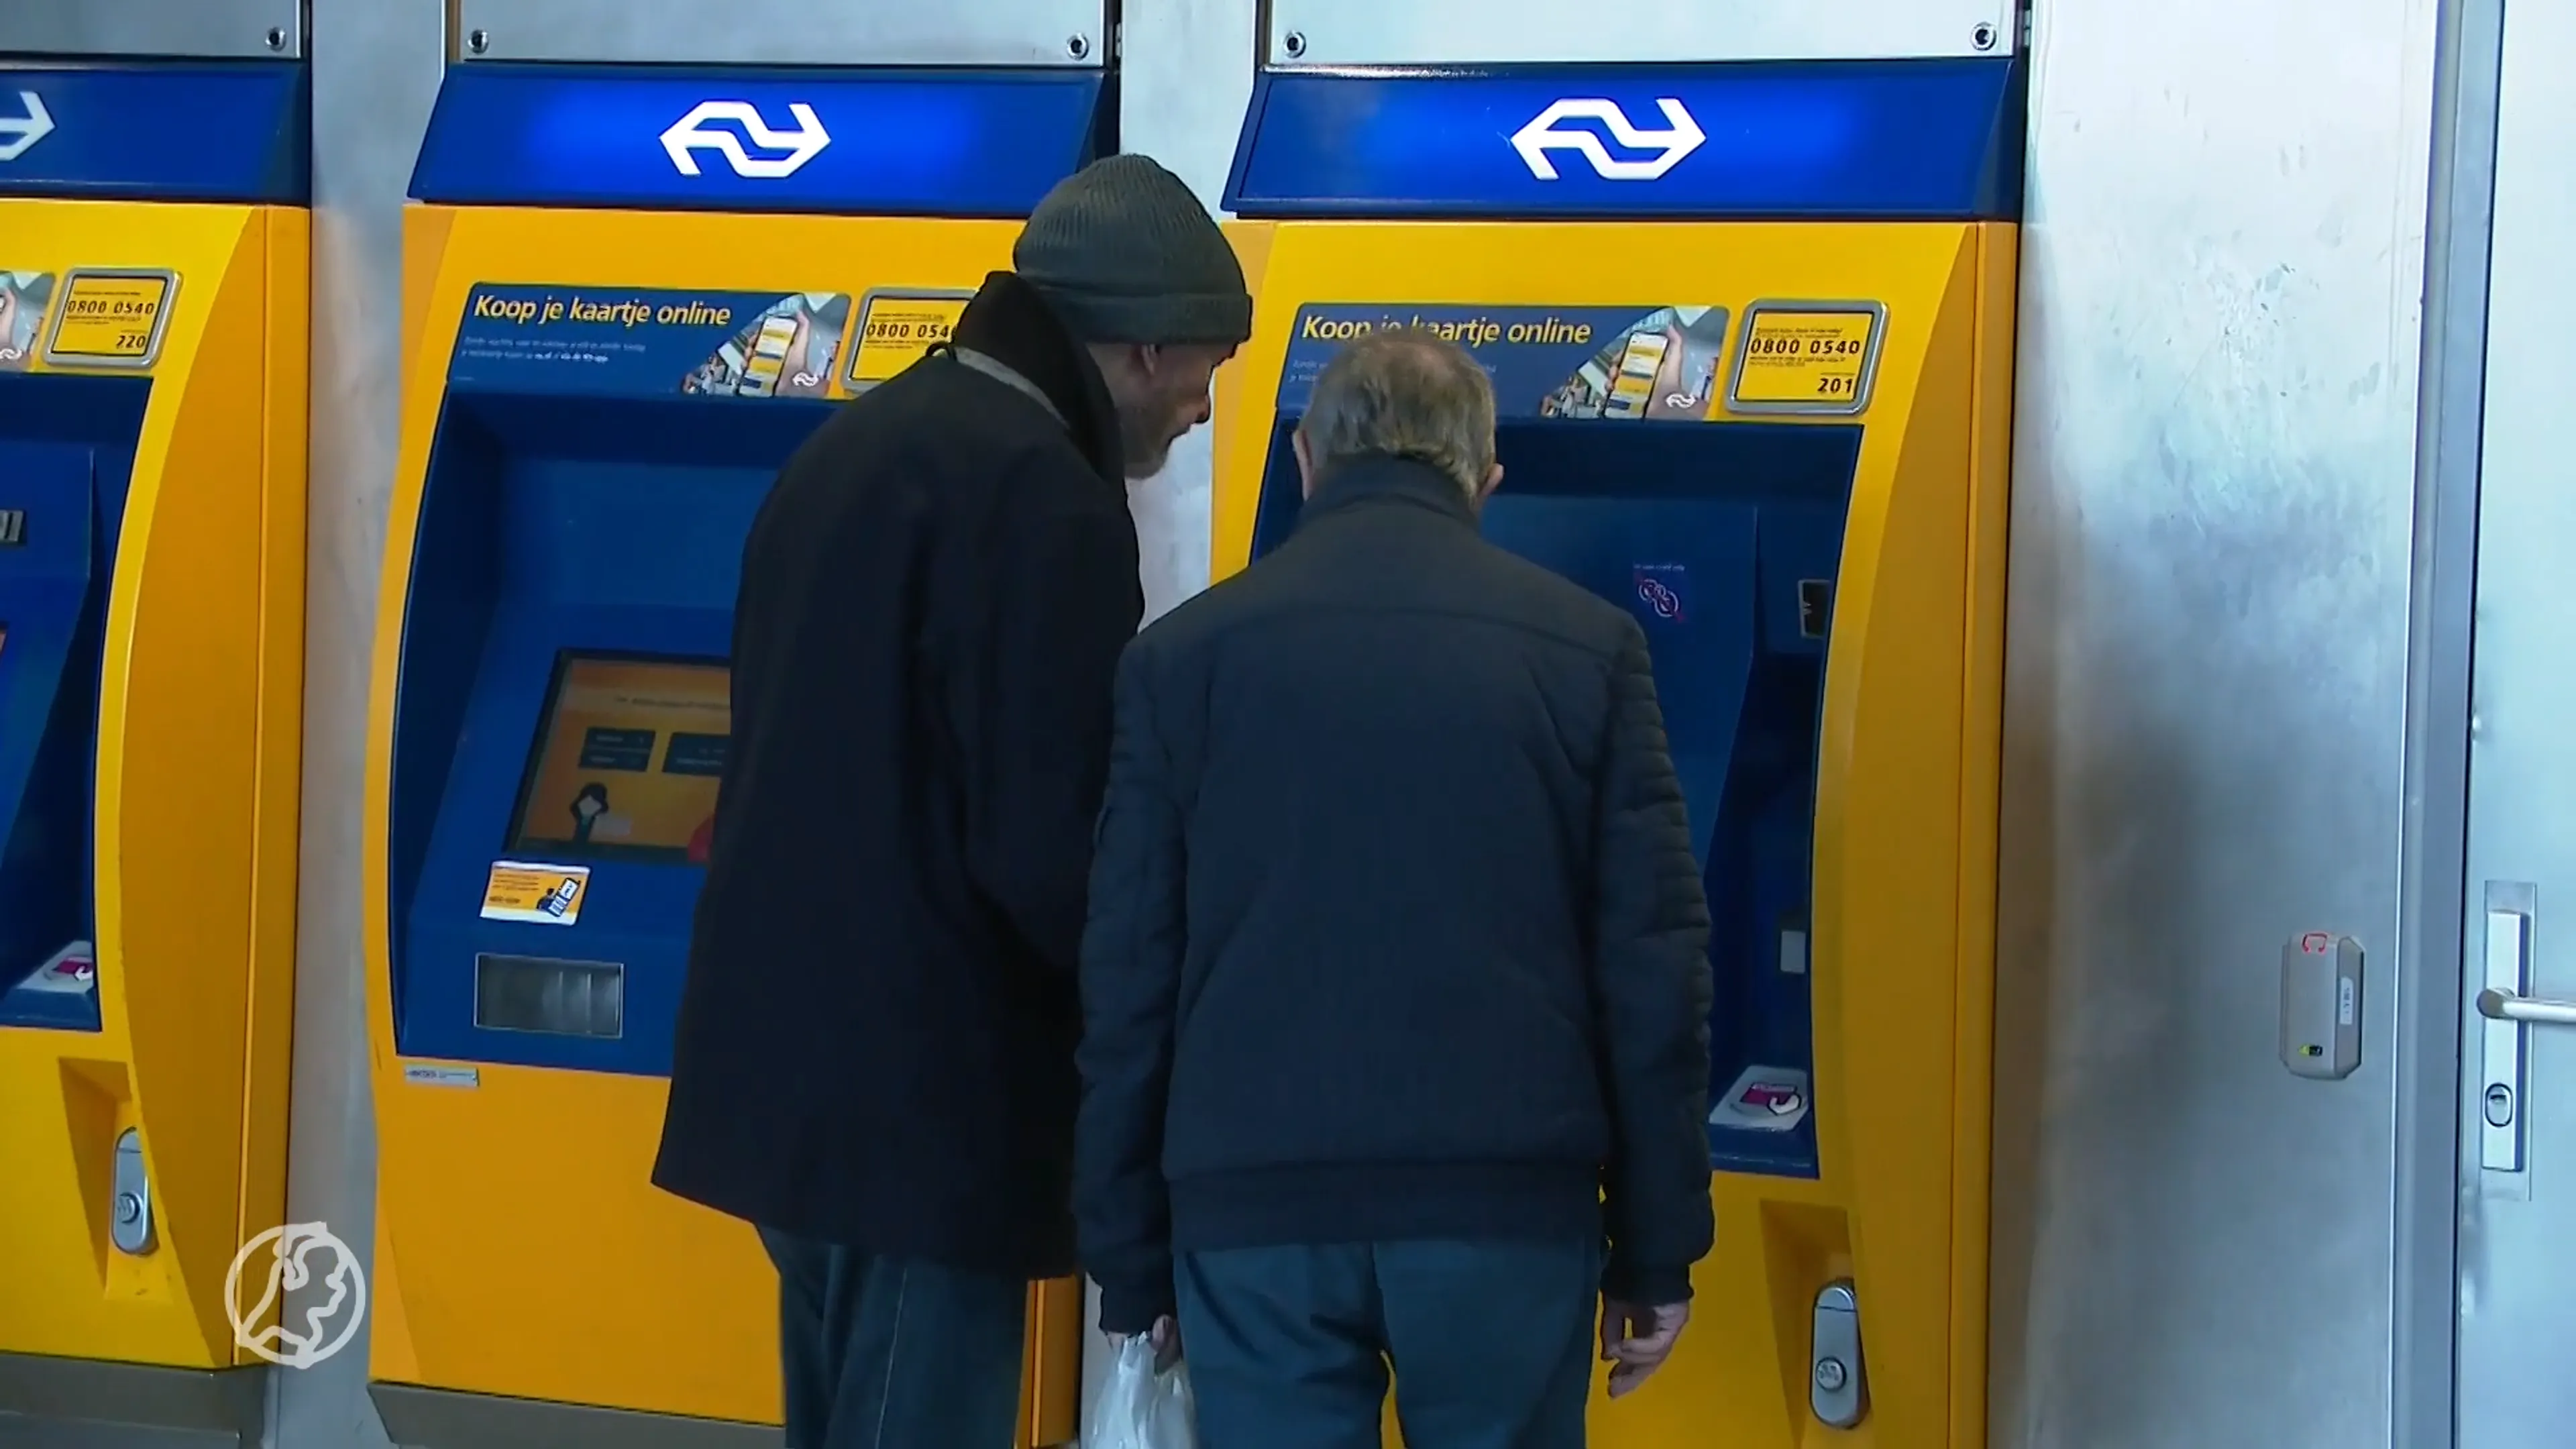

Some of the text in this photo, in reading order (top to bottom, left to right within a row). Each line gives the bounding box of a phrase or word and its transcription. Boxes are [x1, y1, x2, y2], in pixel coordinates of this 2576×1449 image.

[67, 301, 154, 315] 0800 0540
[474, 294, 731, 327] Koop je kaartje online
[866, 323, 954, 338] 0800 054
[1507, 316, 1592, 343] online
[1750, 337, 1860, 354] 0800 0540
[1817, 377, 1854, 393] 201
